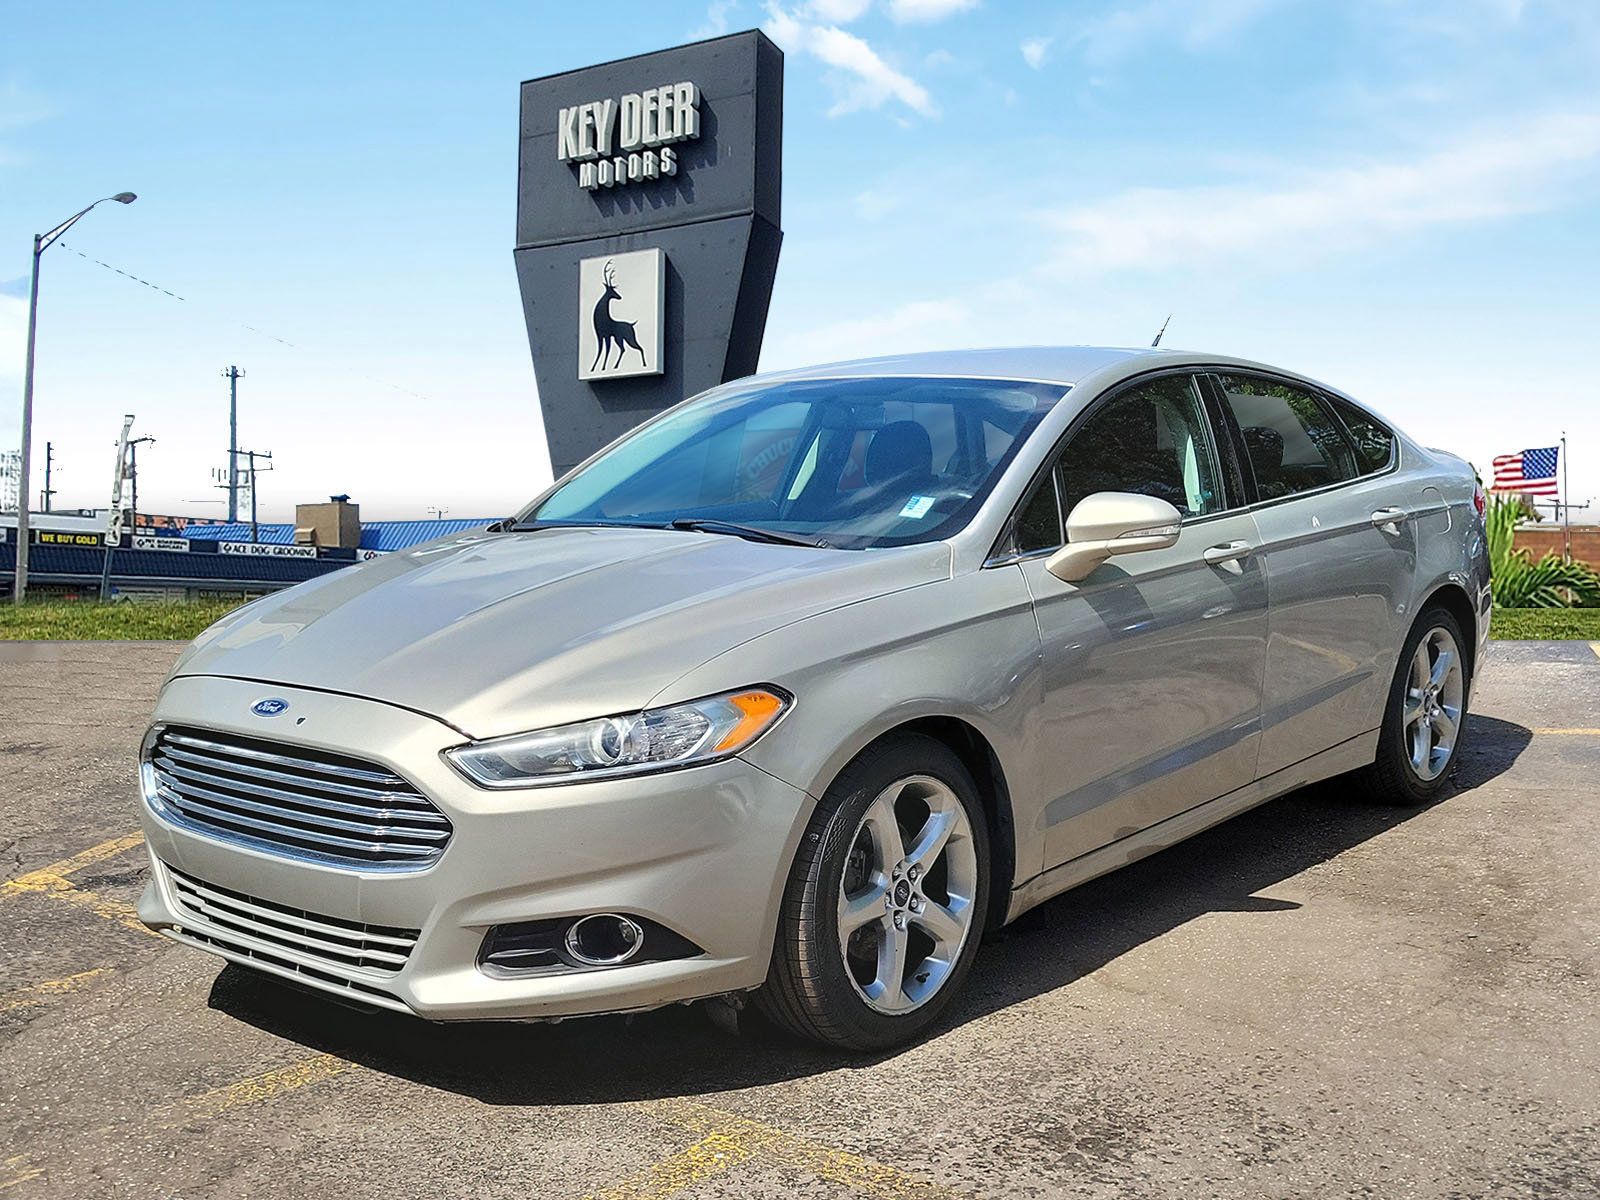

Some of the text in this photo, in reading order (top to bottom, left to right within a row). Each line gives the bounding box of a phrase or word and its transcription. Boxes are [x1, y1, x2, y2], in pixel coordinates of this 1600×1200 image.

[558, 82, 700, 164] KEY DEER
[579, 147, 677, 190] MOTORS
[41, 533, 98, 545] WE BUY GOLD
[232, 545, 315, 557] ACE DOG GROOMING
